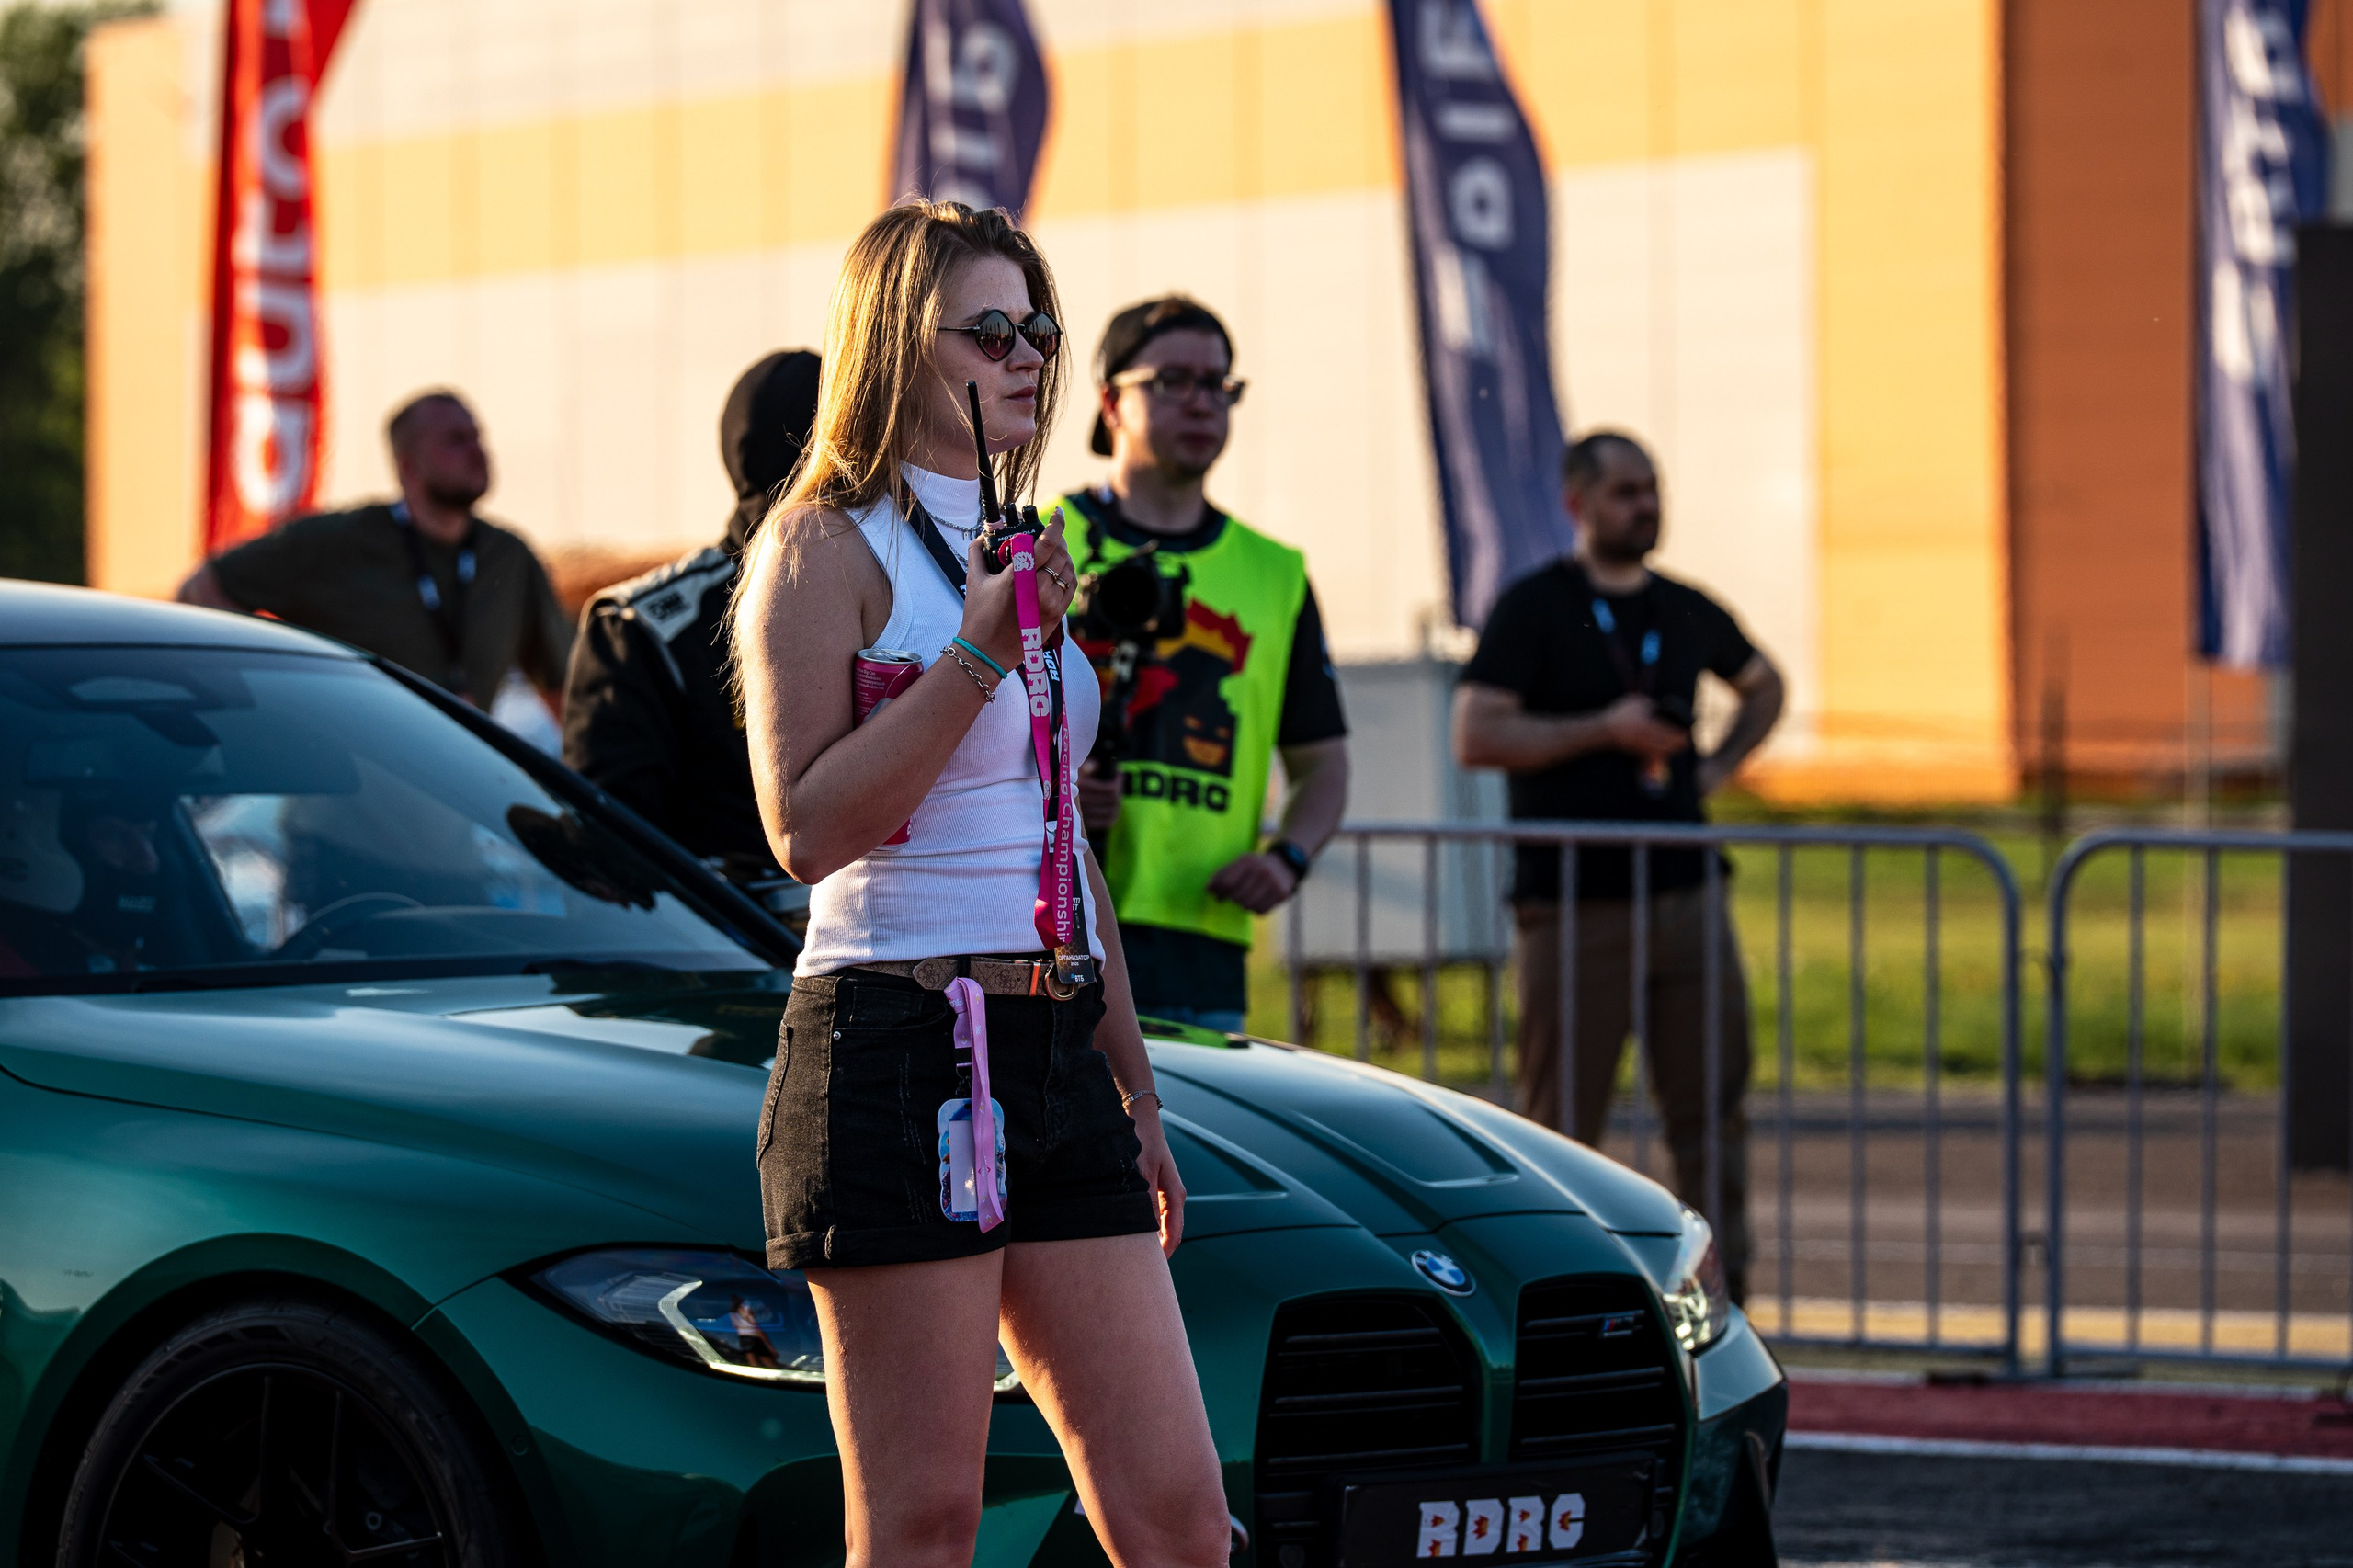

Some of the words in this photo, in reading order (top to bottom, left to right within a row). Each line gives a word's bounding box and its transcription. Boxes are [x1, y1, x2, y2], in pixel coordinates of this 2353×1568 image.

[997, 528, 1036, 542] MOTOLA
[1021, 626, 1050, 717] RDRC
[1060, 727, 1070, 796] Racing
[1416, 1493, 1586, 1558] RDRC
